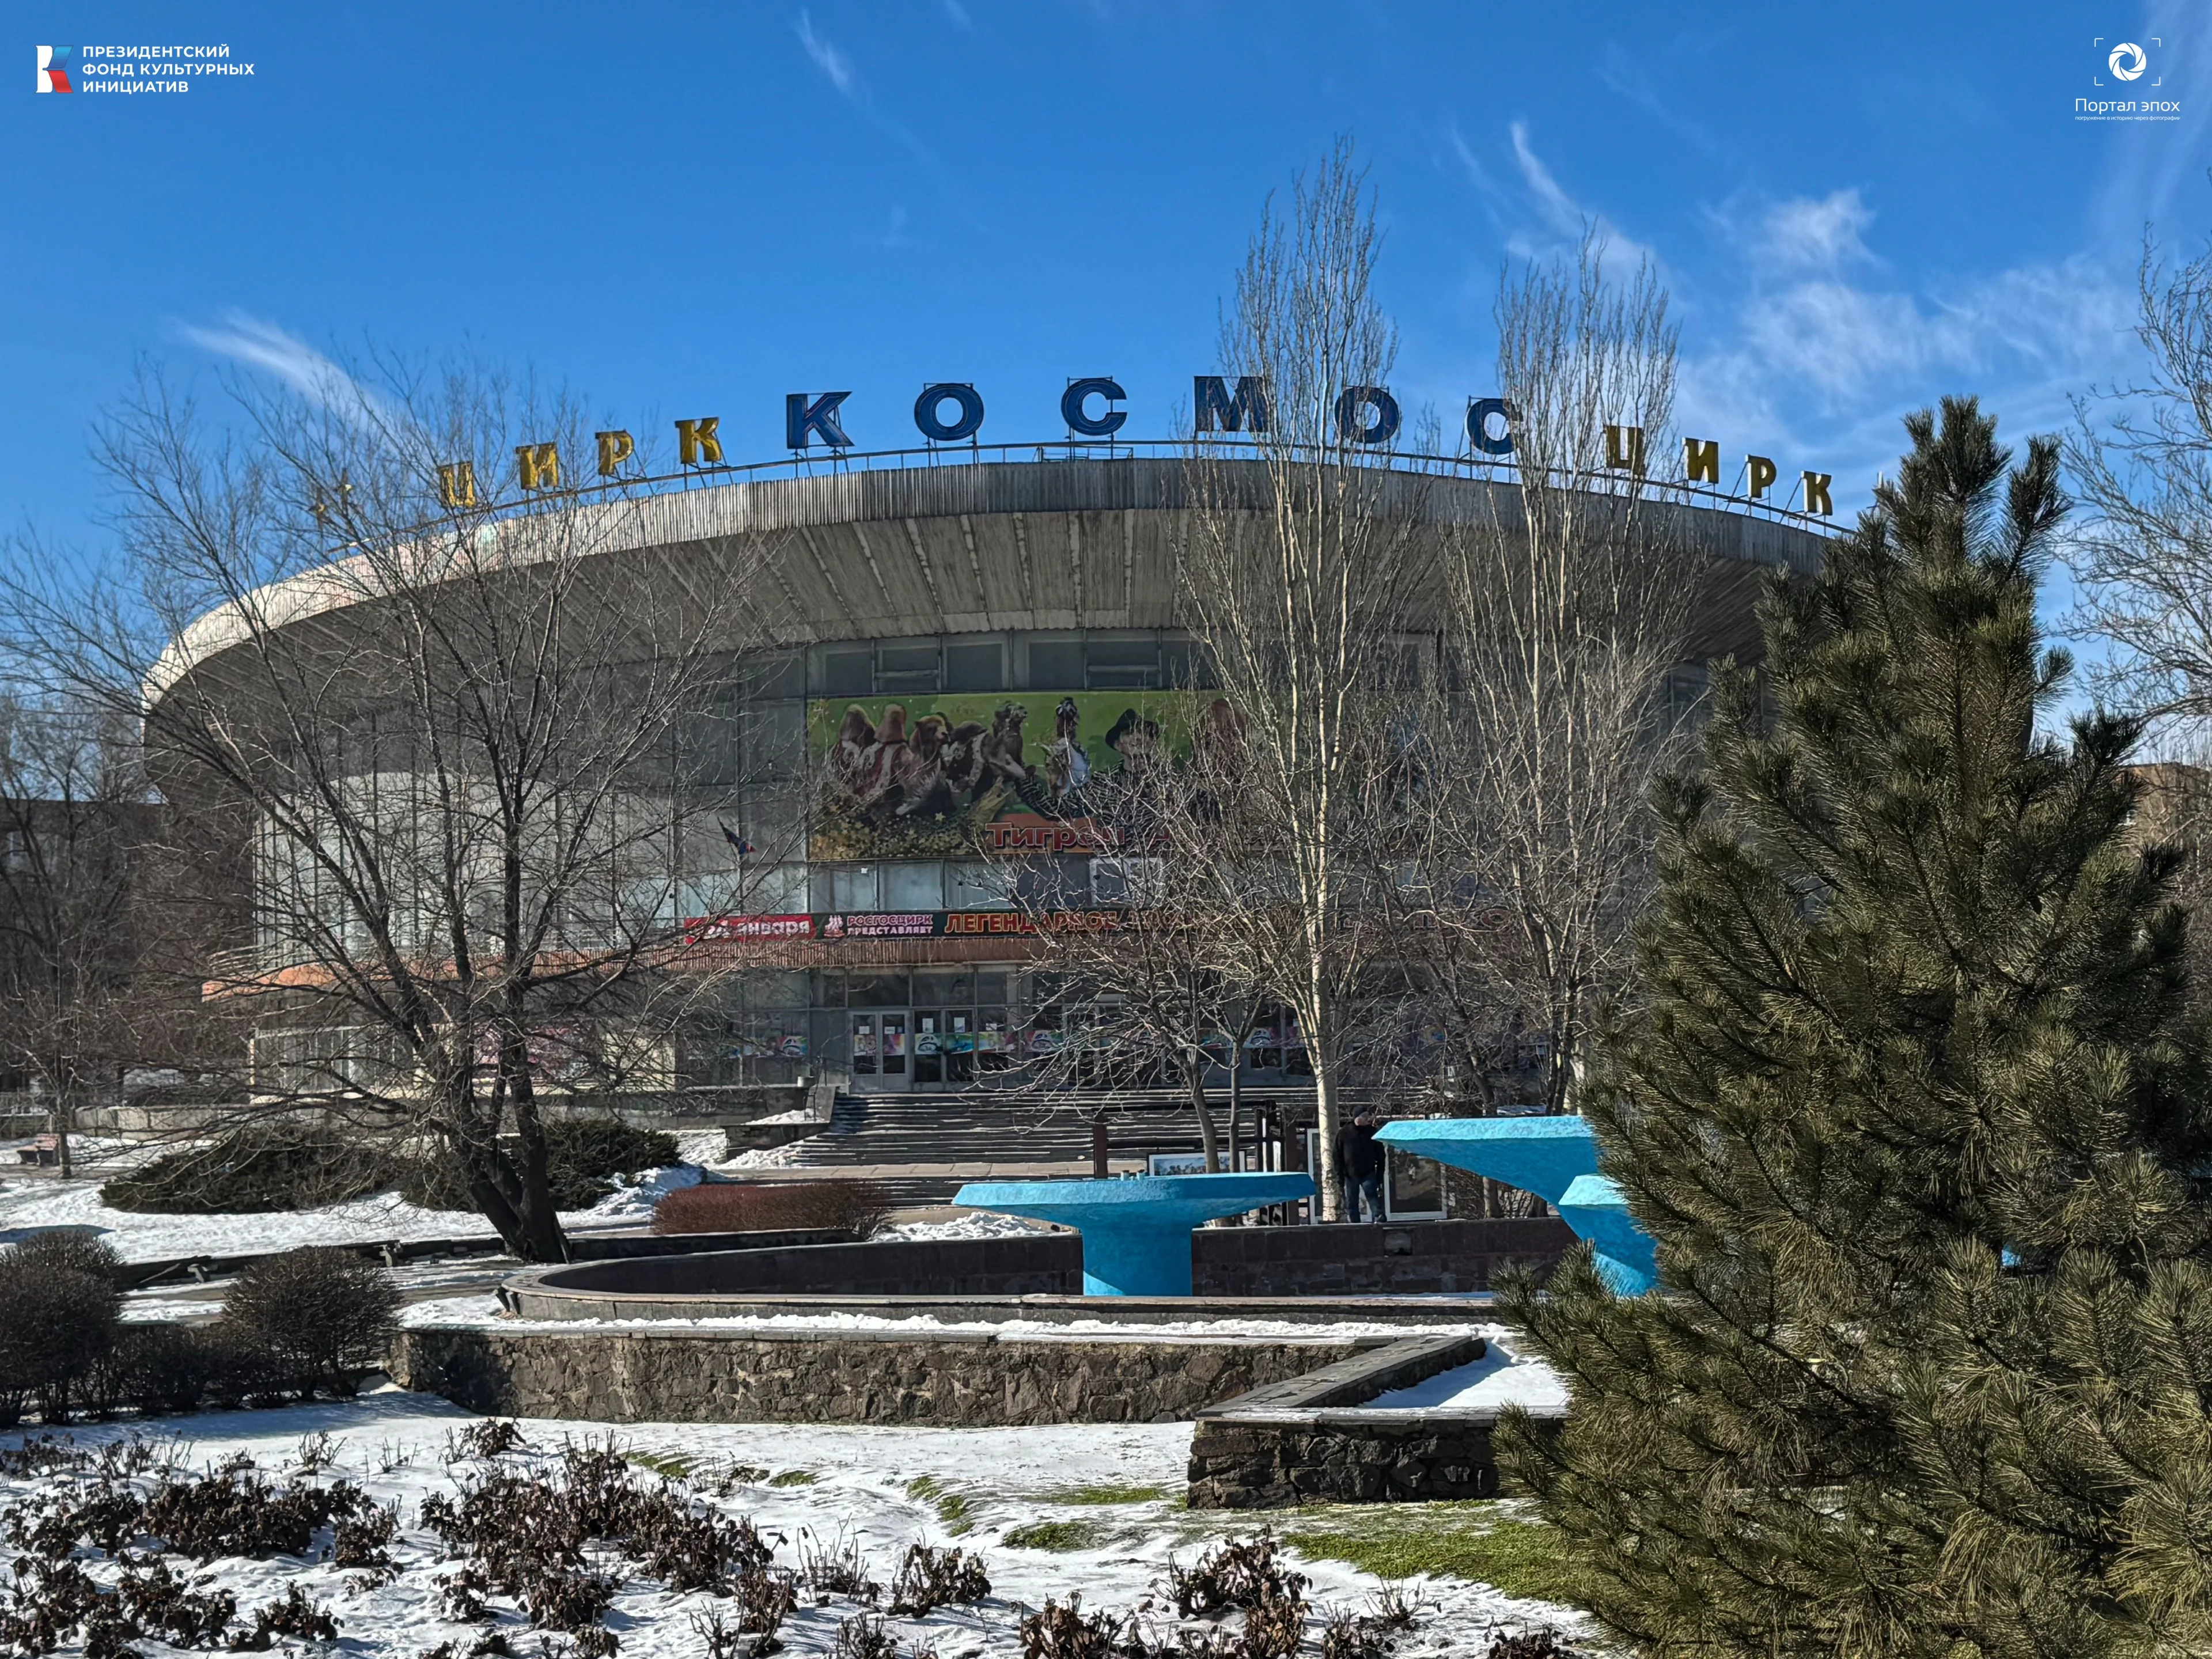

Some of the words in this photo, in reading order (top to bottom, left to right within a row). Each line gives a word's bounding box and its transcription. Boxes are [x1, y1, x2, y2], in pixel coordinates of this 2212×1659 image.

[786, 376, 1524, 454] КОСМОС
[437, 417, 721, 509] ЦИРК
[1603, 425, 1833, 516] ЦИРК
[847, 914, 933, 926] РОСГОСЦИРК
[847, 926, 933, 936] ПРЕДСТАВЛЯЕТ
